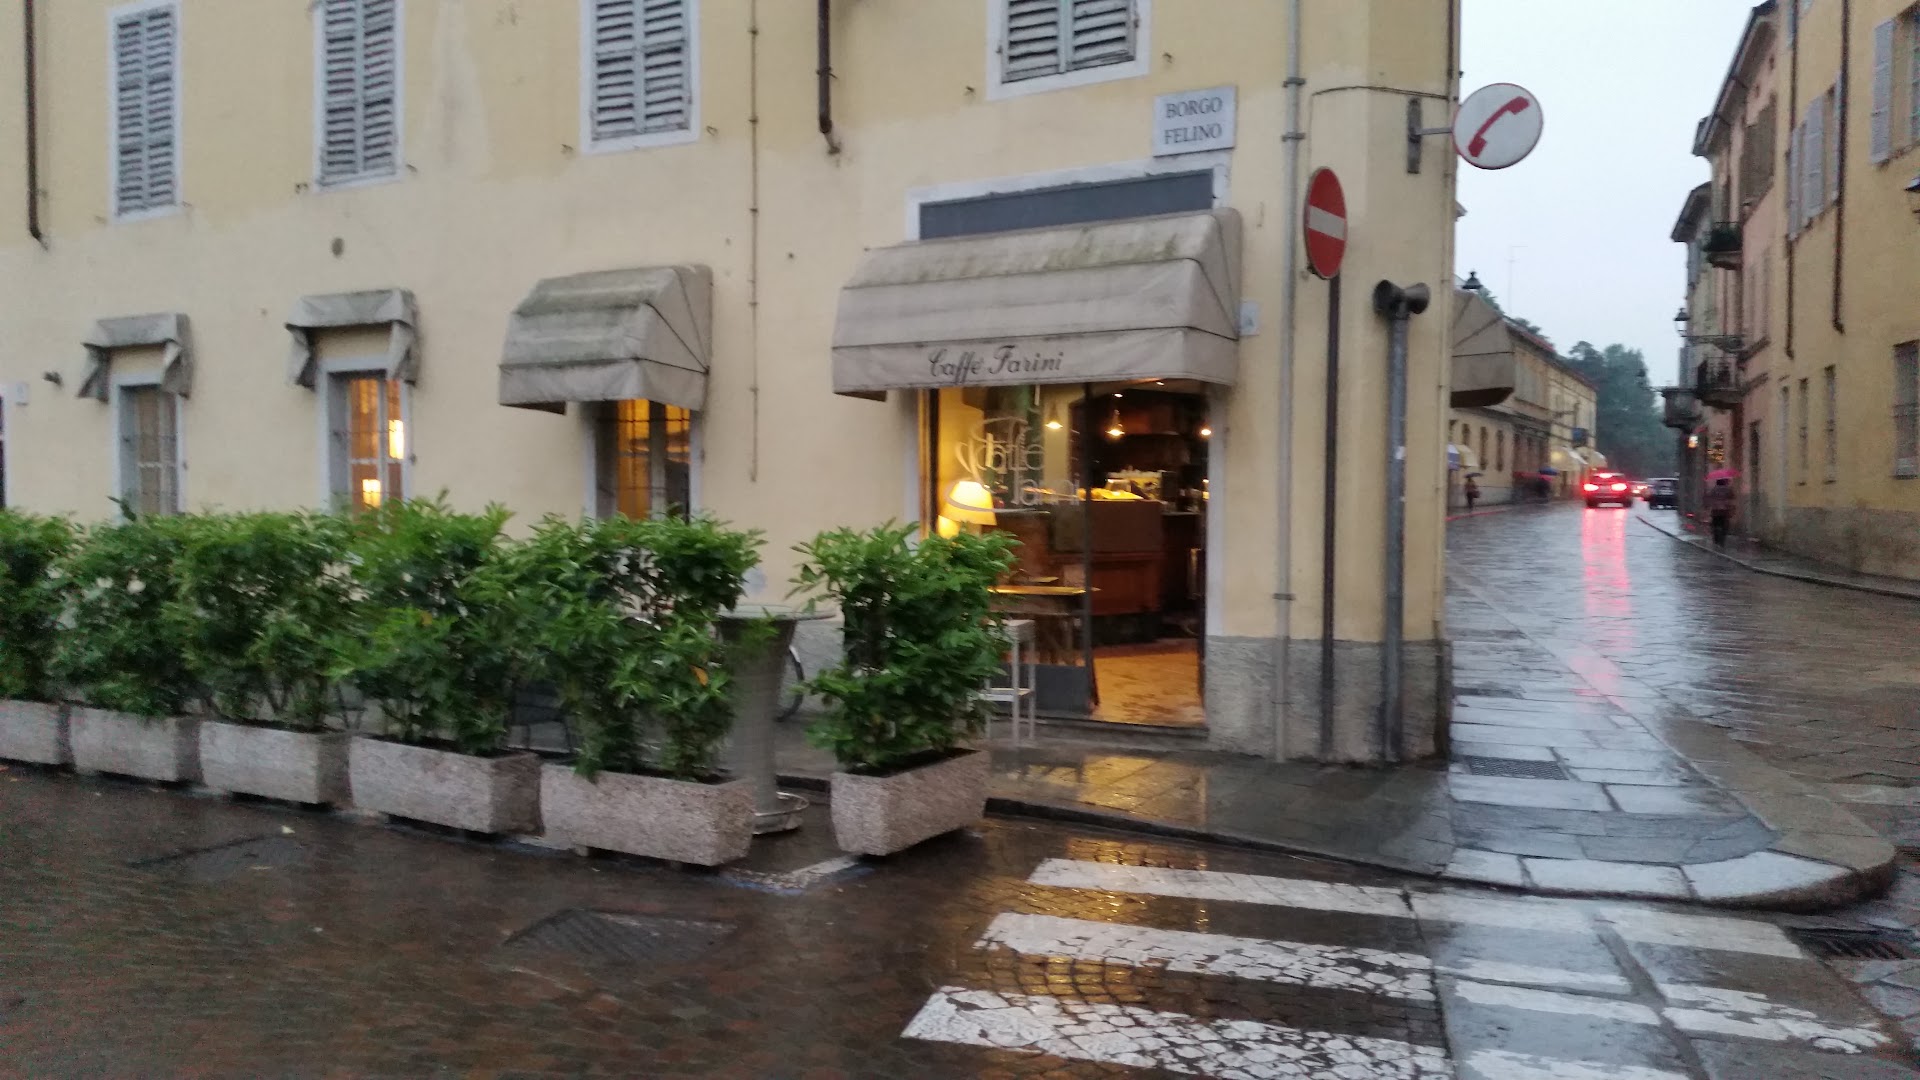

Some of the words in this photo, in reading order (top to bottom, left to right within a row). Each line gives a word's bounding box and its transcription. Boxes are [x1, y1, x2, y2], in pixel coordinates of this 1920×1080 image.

[1166, 97, 1223, 118] BORGO
[1164, 123, 1222, 144] FELINO
[988, 345, 1064, 374] Farini
